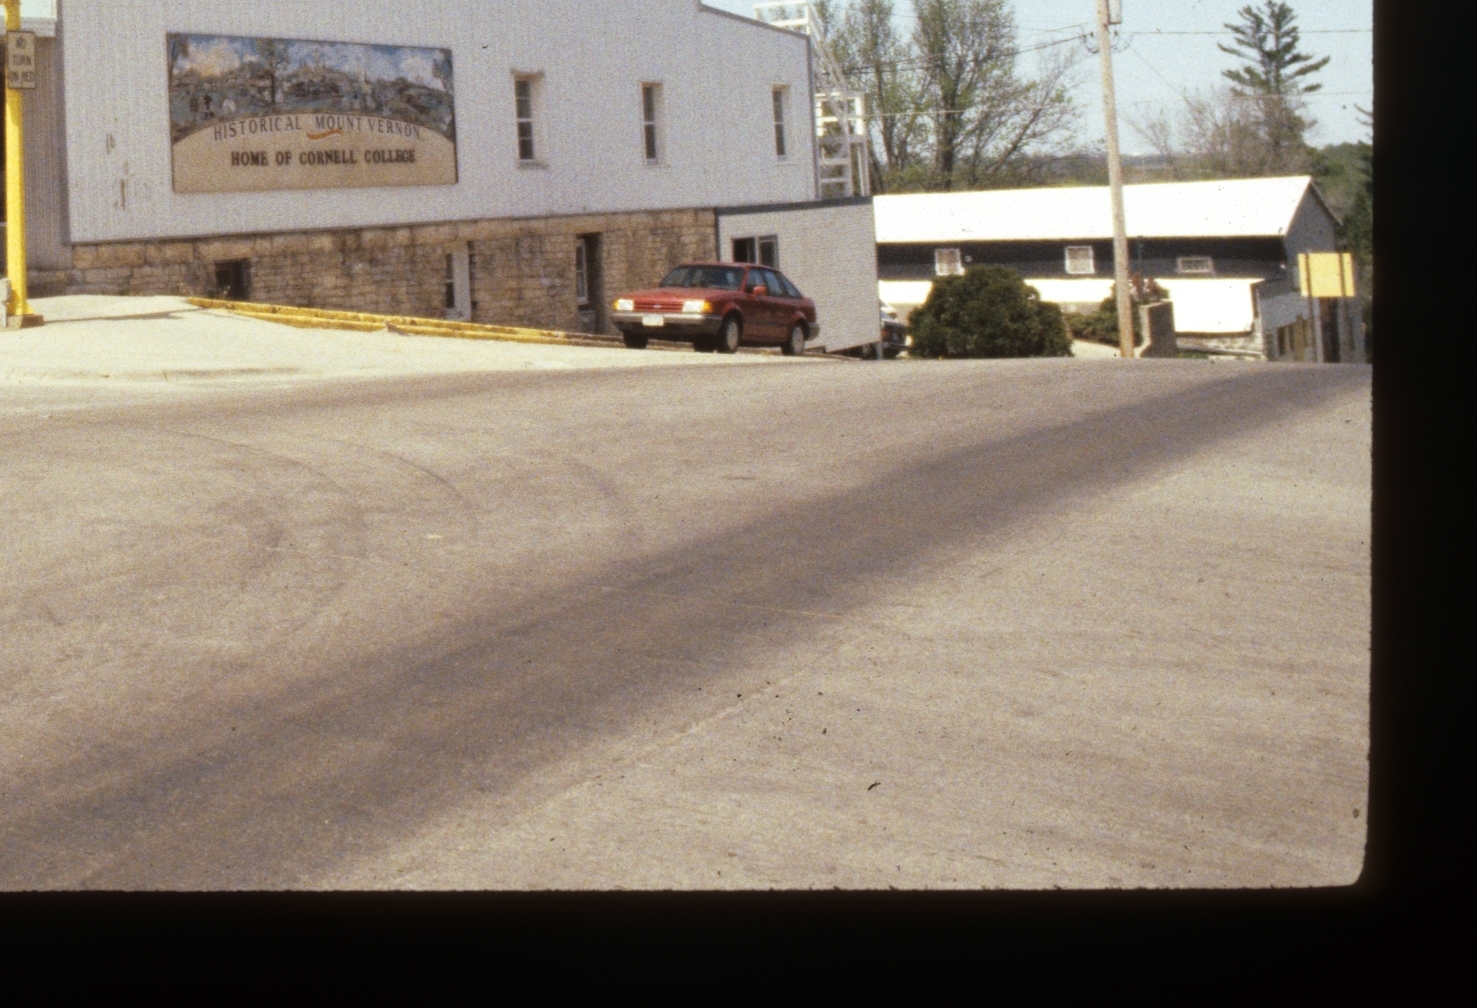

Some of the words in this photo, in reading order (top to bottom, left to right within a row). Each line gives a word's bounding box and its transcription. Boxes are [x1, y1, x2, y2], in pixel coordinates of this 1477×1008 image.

[15, 37, 26, 49] NO
[12, 54, 32, 66] TURN
[8, 71, 20, 82] ON
[21, 71, 34, 82] RED
[213, 115, 302, 141] HISTORICAL
[315, 115, 362, 131] MOUNT
[367, 118, 421, 140] VERNON
[230, 150, 269, 167] HOME
[275, 150, 292, 166] OF
[299, 149, 358, 165] CORNELL
[364, 149, 416, 164] COLLEGE
